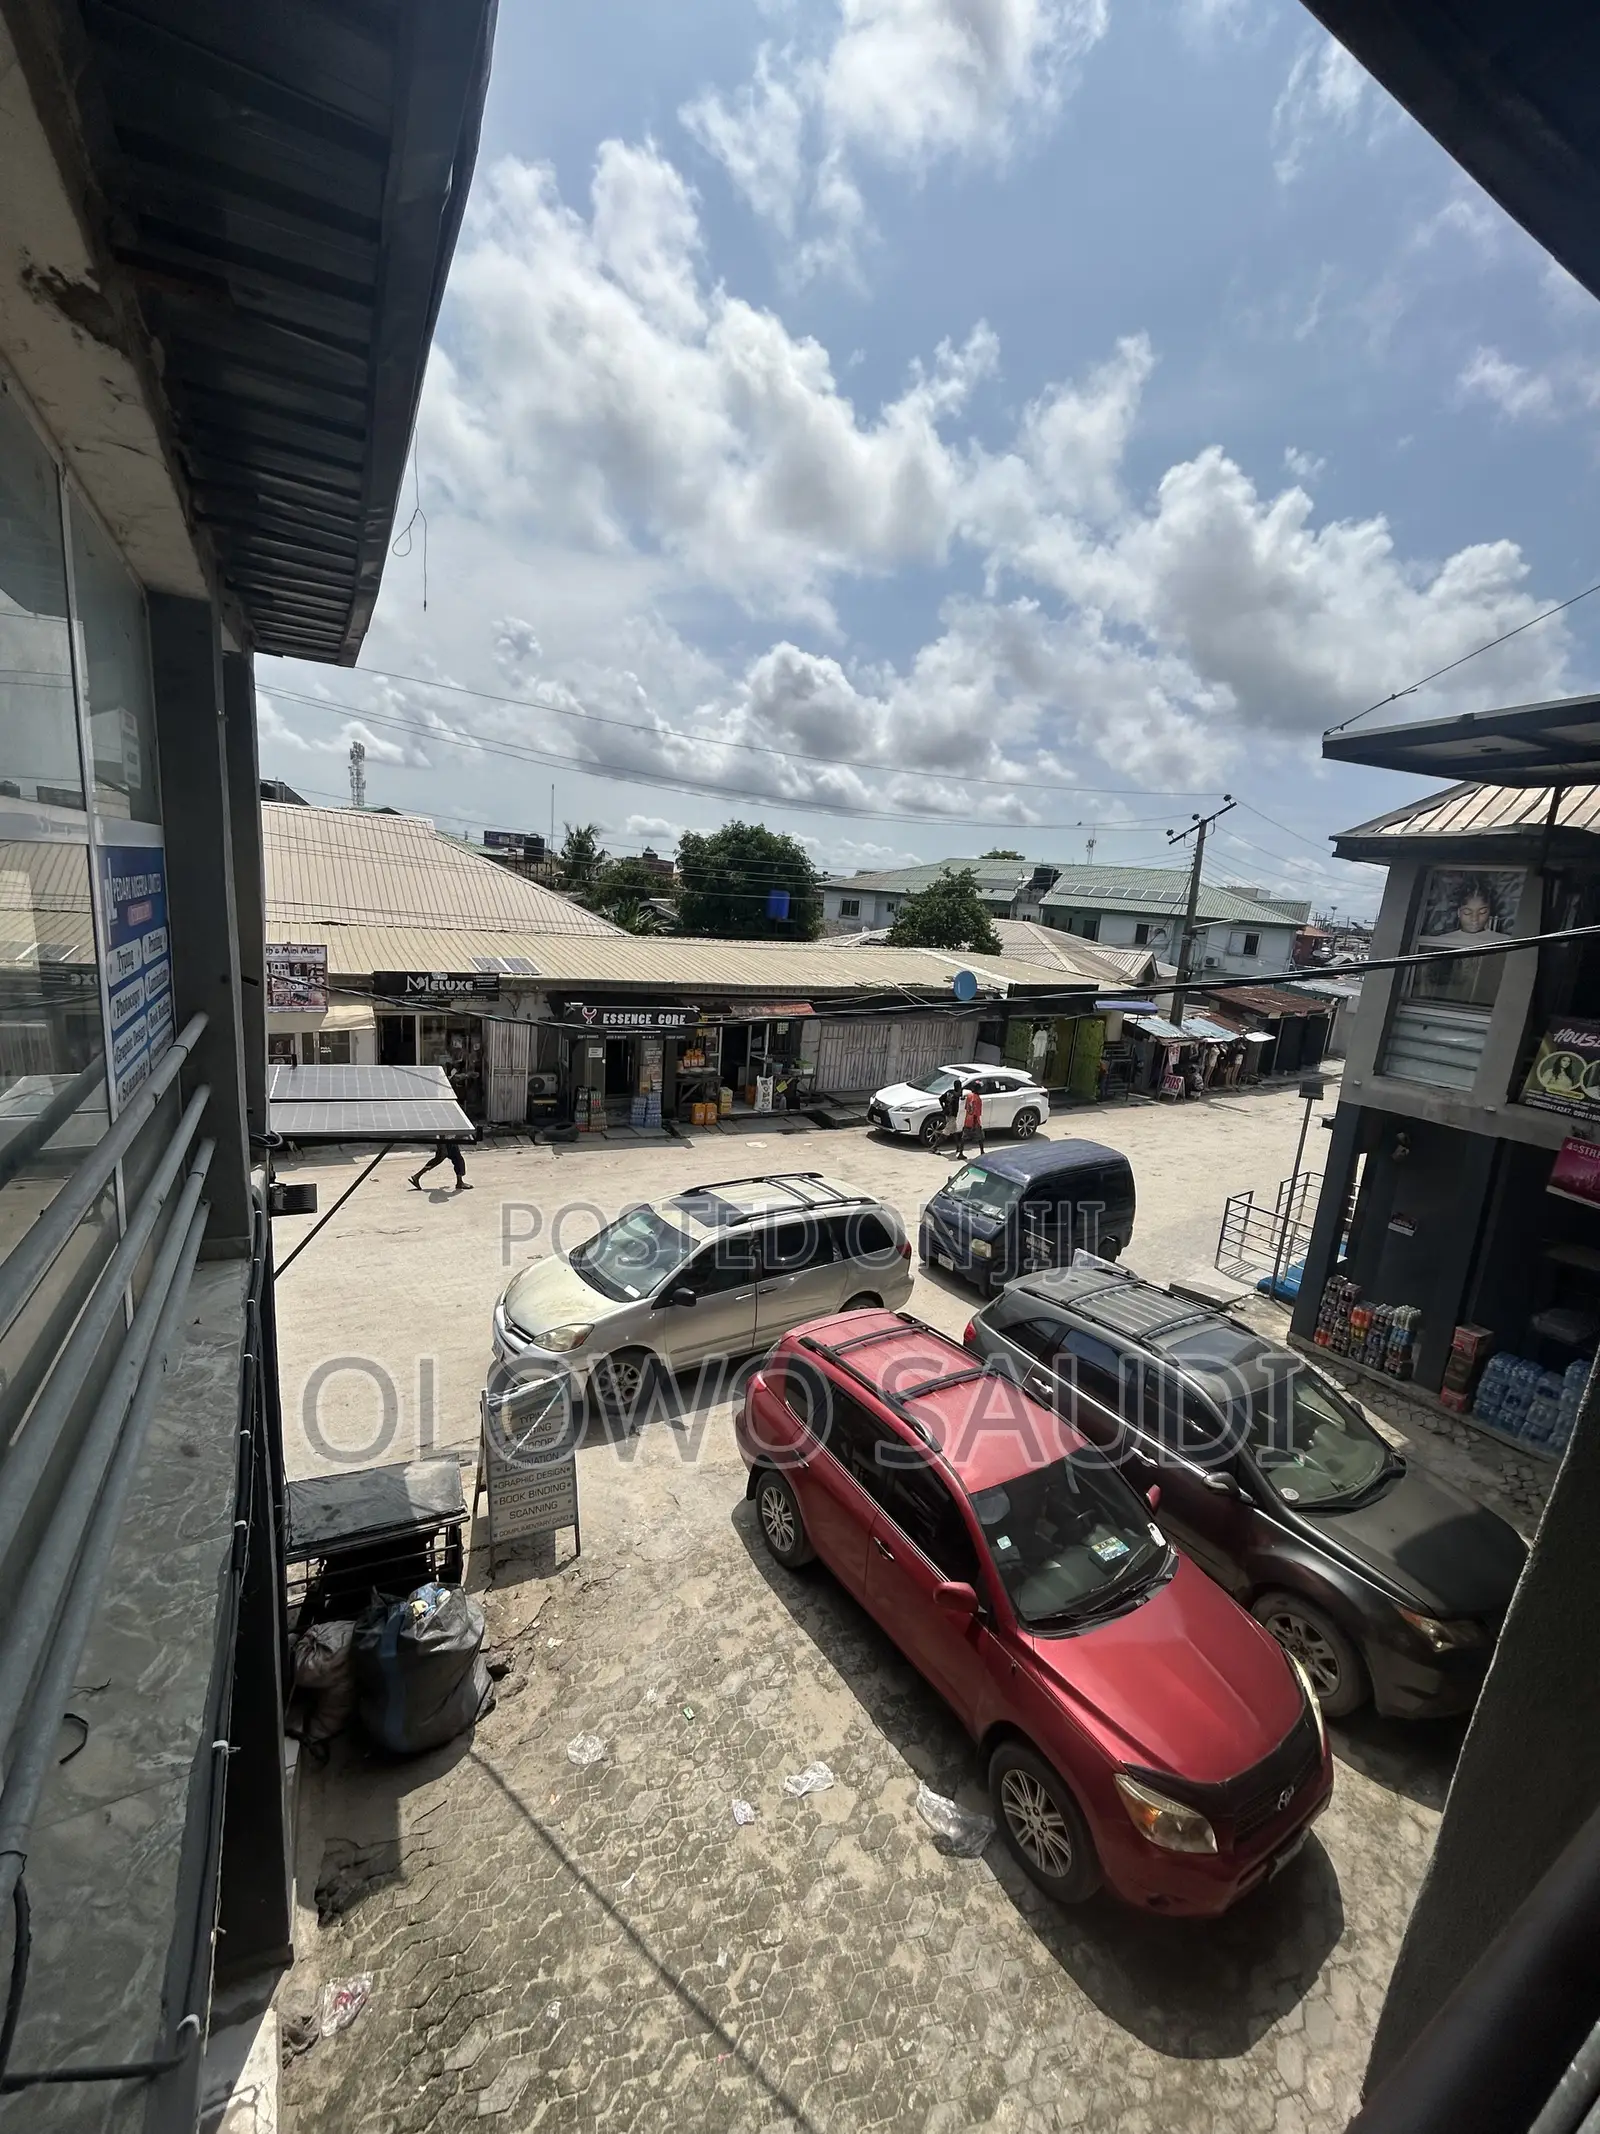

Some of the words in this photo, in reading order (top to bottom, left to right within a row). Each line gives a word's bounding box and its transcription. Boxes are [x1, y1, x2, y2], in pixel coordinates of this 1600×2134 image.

[117, 948, 134, 975] Typing
[281, 946, 299, 954] Mini
[115, 988, 141, 1019] Photocopy
[602, 1013, 652, 1025] ESSENCE
[658, 1014, 686, 1025] CORE
[116, 1035, 132, 1064] Graphic
[132, 1024, 146, 1047] Design
[121, 1062, 147, 1101] Scanning
[1164, 1076, 1181, 1089] POS
[498, 1475, 534, 1490] GRAPHIC
[536, 1466, 566, 1481] DESIGN
[499, 1492, 526, 1506] BOOK
[528, 1481, 566, 1498] BINDING
[509, 1500, 558, 1520] SCANNING
